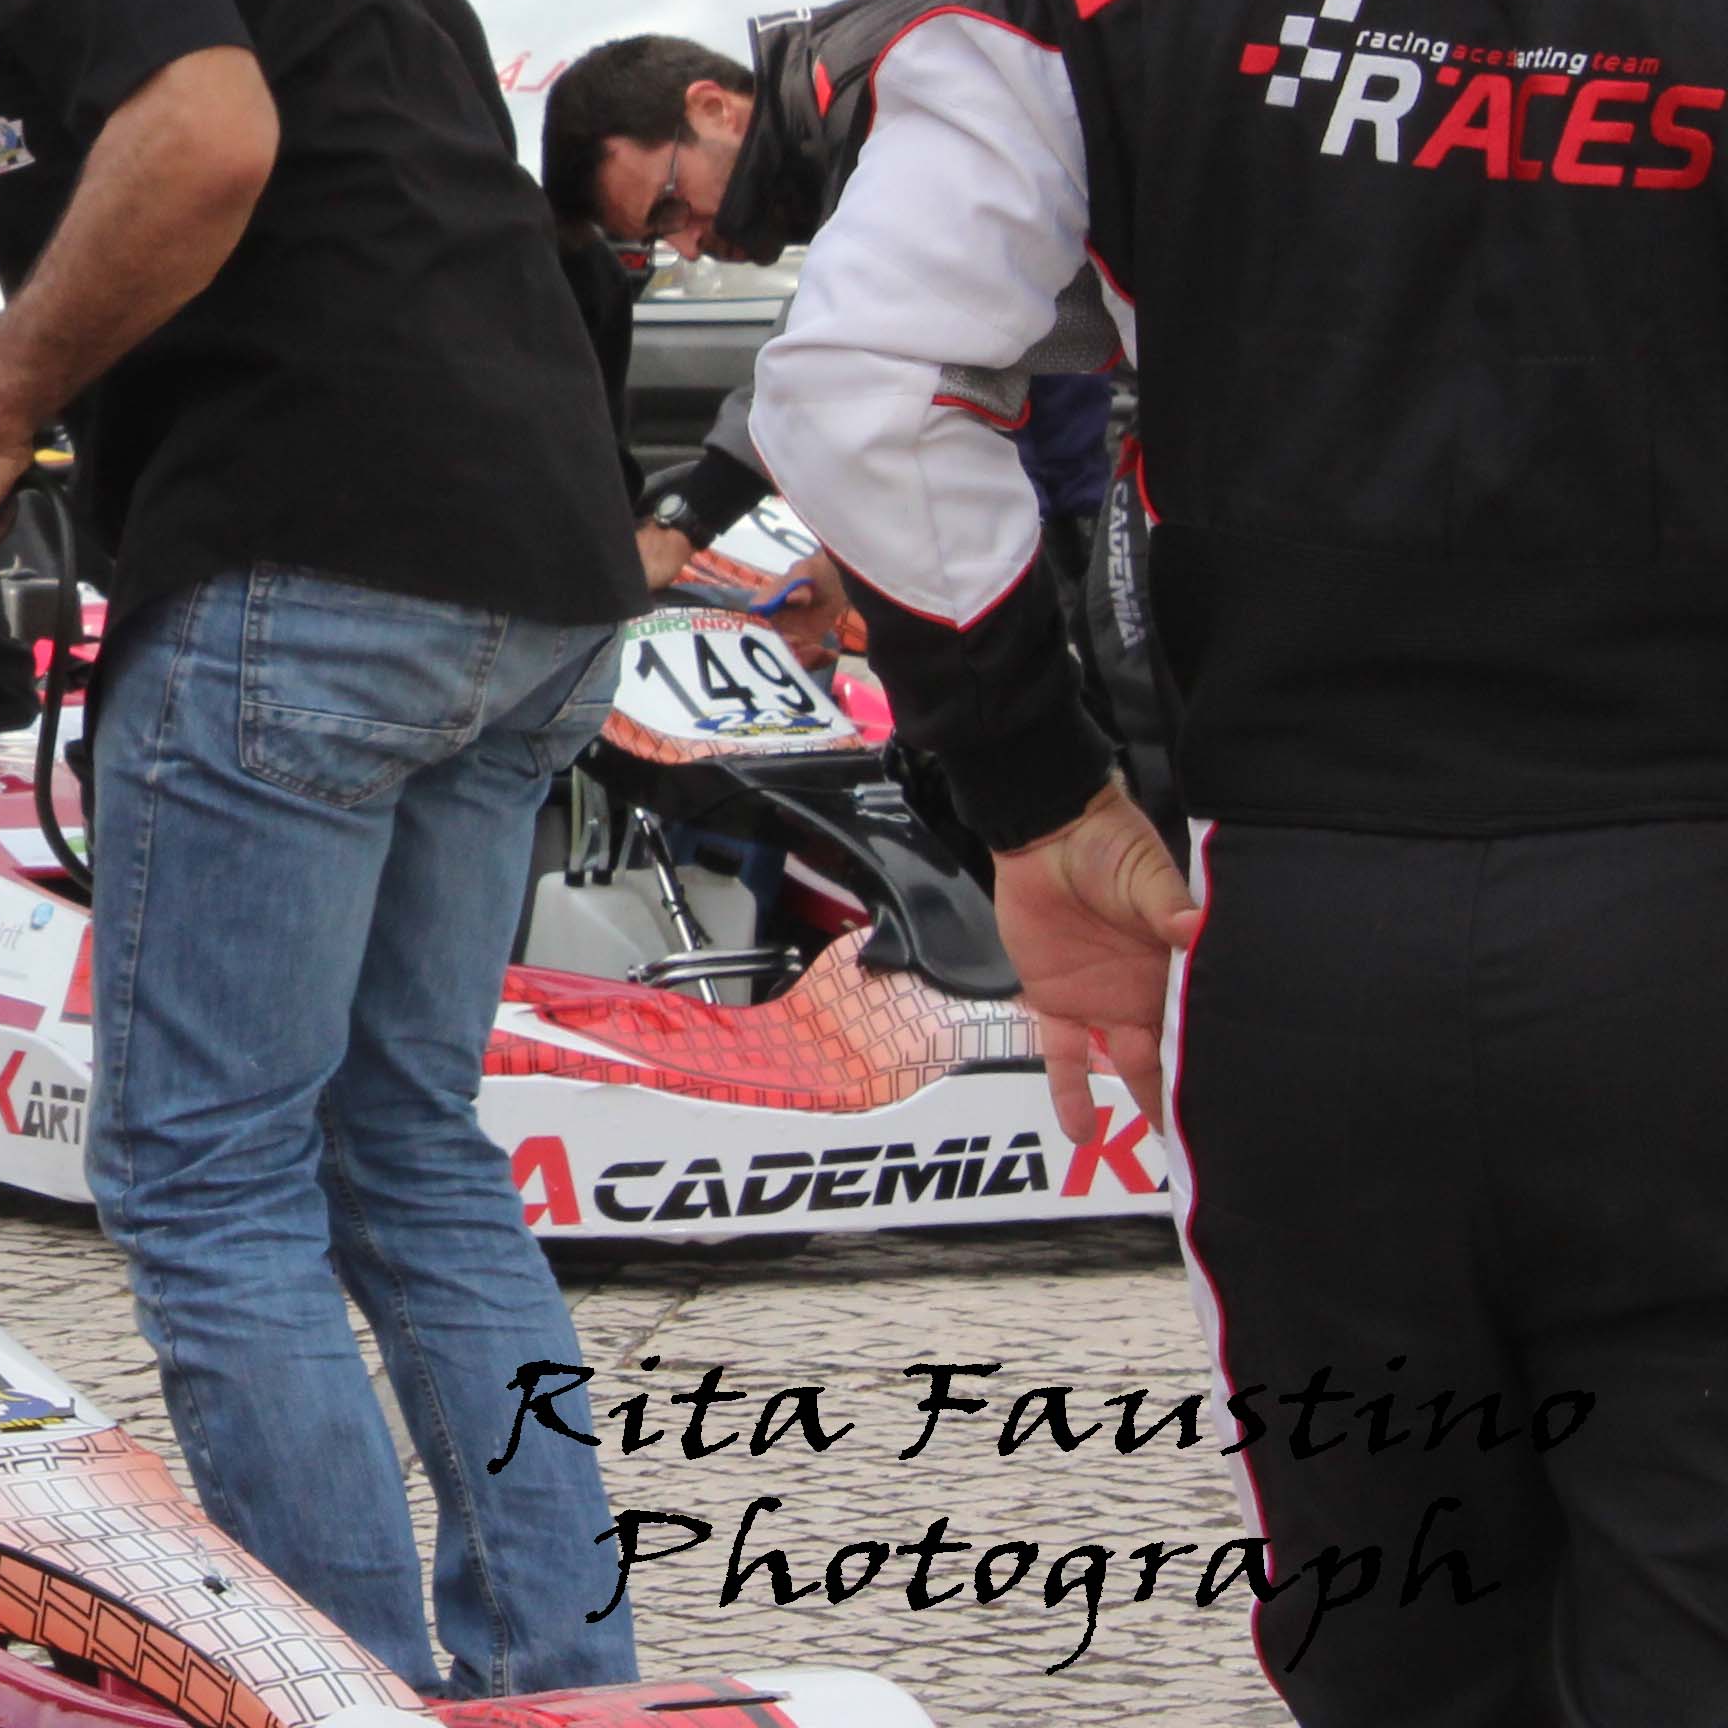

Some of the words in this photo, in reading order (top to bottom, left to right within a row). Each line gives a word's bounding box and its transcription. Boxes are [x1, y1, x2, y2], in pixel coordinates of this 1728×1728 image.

[1356, 30, 1449, 63] racing
[1592, 51, 1661, 74] team
[635, 633, 816, 720] 149
[508, 1129, 1050, 1228] ACADEMIA
